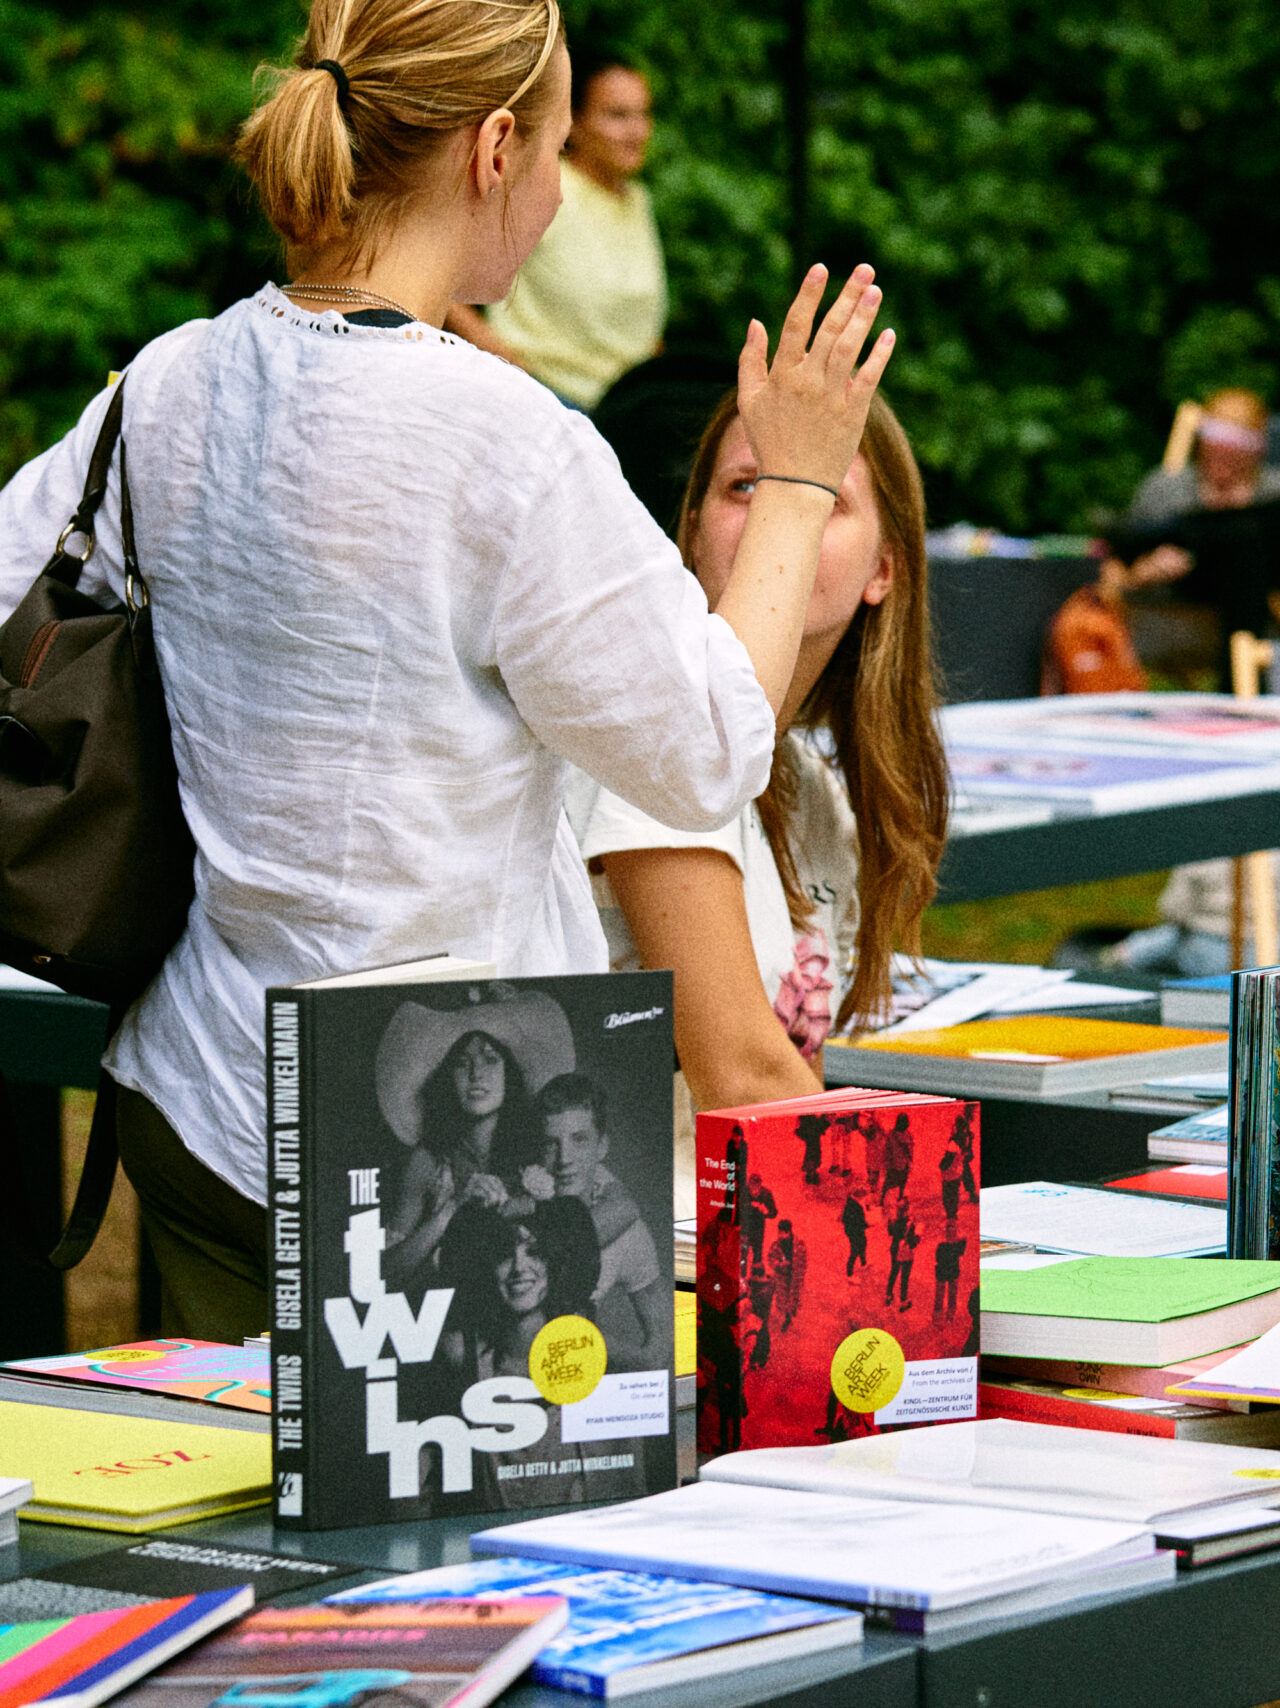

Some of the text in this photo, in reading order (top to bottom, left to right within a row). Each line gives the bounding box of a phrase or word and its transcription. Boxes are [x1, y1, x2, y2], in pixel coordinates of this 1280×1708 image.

[272, 1001, 301, 1330] GISELA GETTY & JUTTA WINKELMANN
[705, 1157, 735, 1171] The End
[699, 1178, 736, 1191] the World
[727, 1172, 735, 1181] of
[348, 1168, 381, 1206] THE
[548, 1335, 594, 1355] BERLIN
[541, 1352, 567, 1370] ART
[843, 1335, 881, 1381] BERLIN
[545, 1362, 585, 1382] WEEK
[847, 1367, 868, 1396] ART
[856, 1362, 887, 1400] WEEK
[921, 1368, 935, 1376] dem
[936, 1367, 956, 1375] Archiv
[1079, 1372, 1100, 1384] OWN
[276, 1354, 303, 1412] TWINS
[912, 1379, 928, 1387] From
[929, 1378, 940, 1386] the
[941, 1377, 966, 1385] archives
[960, 1392, 973, 1402] FÜR
[895, 1404, 950, 1416] ZEITGENÖSSISCHE
[951, 1403, 973, 1412] KUNST
[278, 1416, 303, 1451] THE
[496, 1464, 525, 1480] GISELA
[525, 1461, 548, 1478] GETTY
[557, 1458, 582, 1474] JUTTA
[583, 1453, 635, 1472] WINKELMANN
